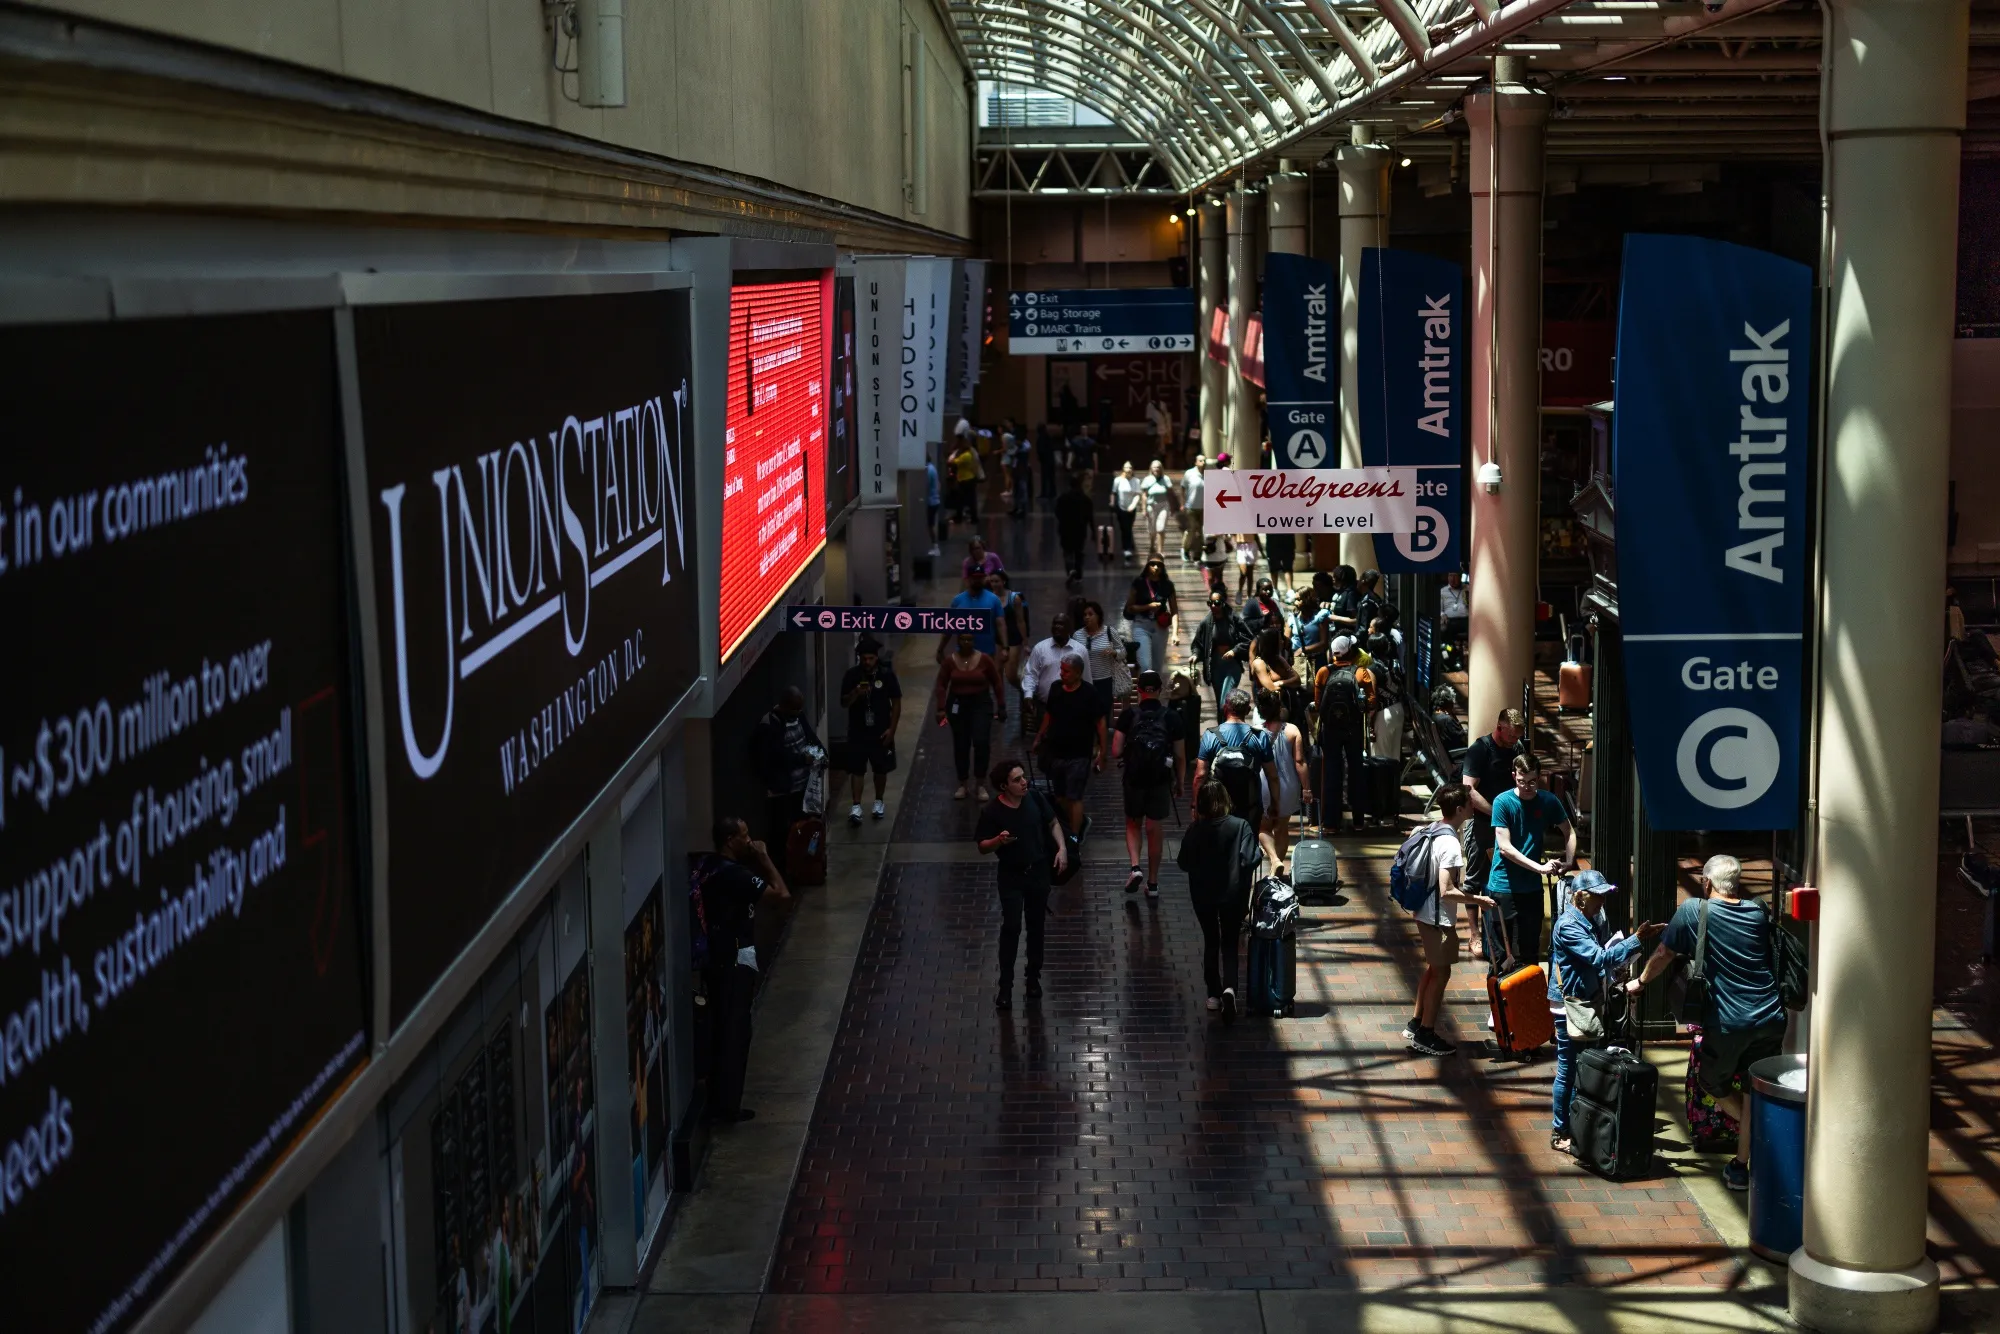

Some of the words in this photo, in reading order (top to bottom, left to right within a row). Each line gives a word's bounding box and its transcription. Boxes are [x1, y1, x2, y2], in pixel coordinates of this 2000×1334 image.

[870, 282, 880, 367] UNION
[1040, 293, 1059, 303] Exit
[1040, 309, 1060, 321] Bag
[1062, 308, 1101, 321] Storage
[1040, 323, 1070, 334] MARC
[1073, 323, 1102, 334] Trains
[1303, 282, 1327, 383] Amtrak
[1418, 293, 1451, 439] Amtrak
[872, 377, 882, 494] STATION
[1287, 410, 1325, 424] Gate
[1294, 434, 1319, 459] A
[1725, 317, 1791, 584] Amtrak
[14, 484, 43, 570] in
[48, 488, 99, 560] our
[101, 440, 249, 543] communities
[1249, 472, 1405, 507] Walgreens
[1416, 480, 1449, 497] ate
[1256, 513, 1314, 529] Lower
[1323, 513, 1374, 529] Level
[1411, 515, 1438, 553] B
[841, 612, 876, 630] Exit
[918, 613, 985, 631] Tickets
[1681, 655, 1779, 692] Gate
[118, 667, 199, 765] million
[202, 656, 227, 718] to
[228, 637, 272, 704] over
[500, 648, 618, 798] WASHINGTON
[624, 627, 647, 684] D.C.
[1695, 724, 1748, 792] C
[0, 820, 113, 958] support
[115, 787, 146, 889] of
[146, 753, 240, 859] housing,
[241, 704, 291, 796] small
[94, 844, 247, 1010] sustainability
[248, 803, 287, 888] and
